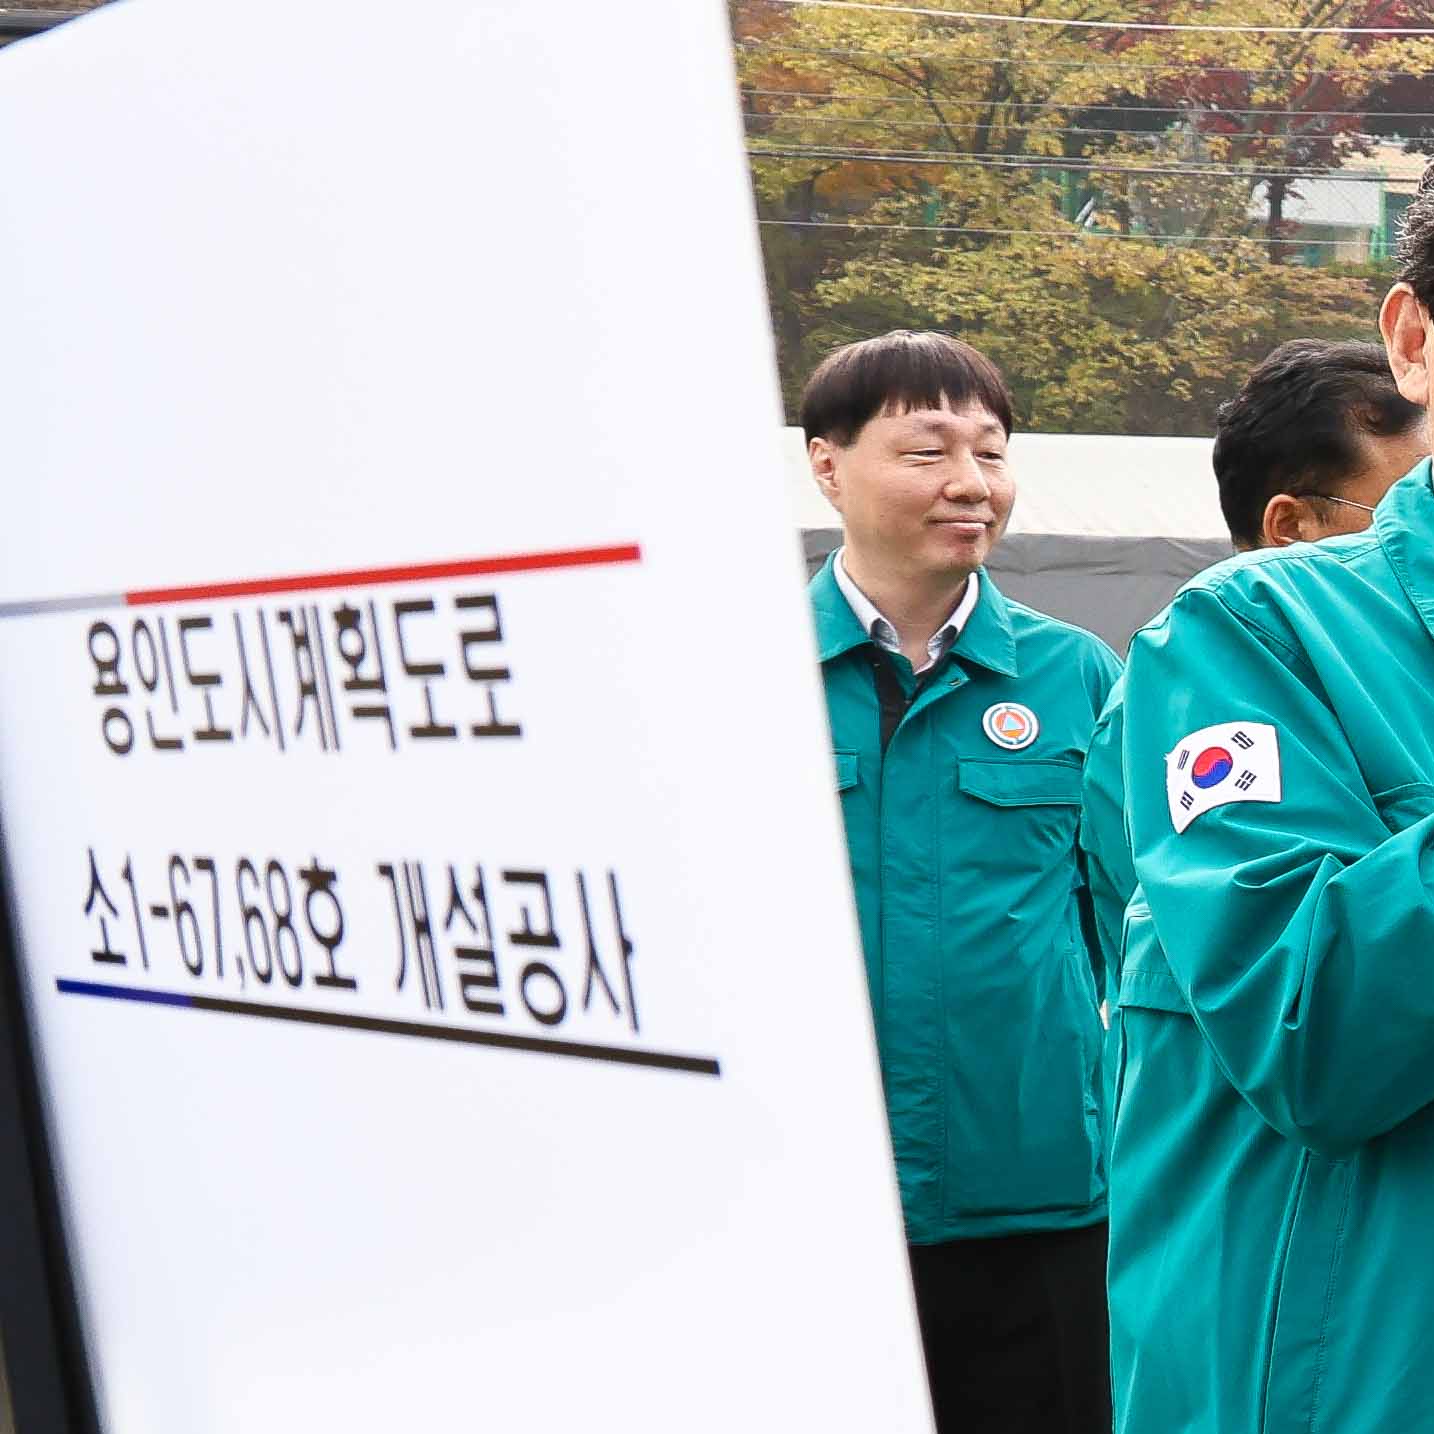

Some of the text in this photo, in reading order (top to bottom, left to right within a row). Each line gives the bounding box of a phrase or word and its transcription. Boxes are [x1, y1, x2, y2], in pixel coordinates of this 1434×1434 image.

[87, 594, 524, 757] 용인도시계획도로
[83, 846, 641, 1034] 소1-67,68호 개설공사
